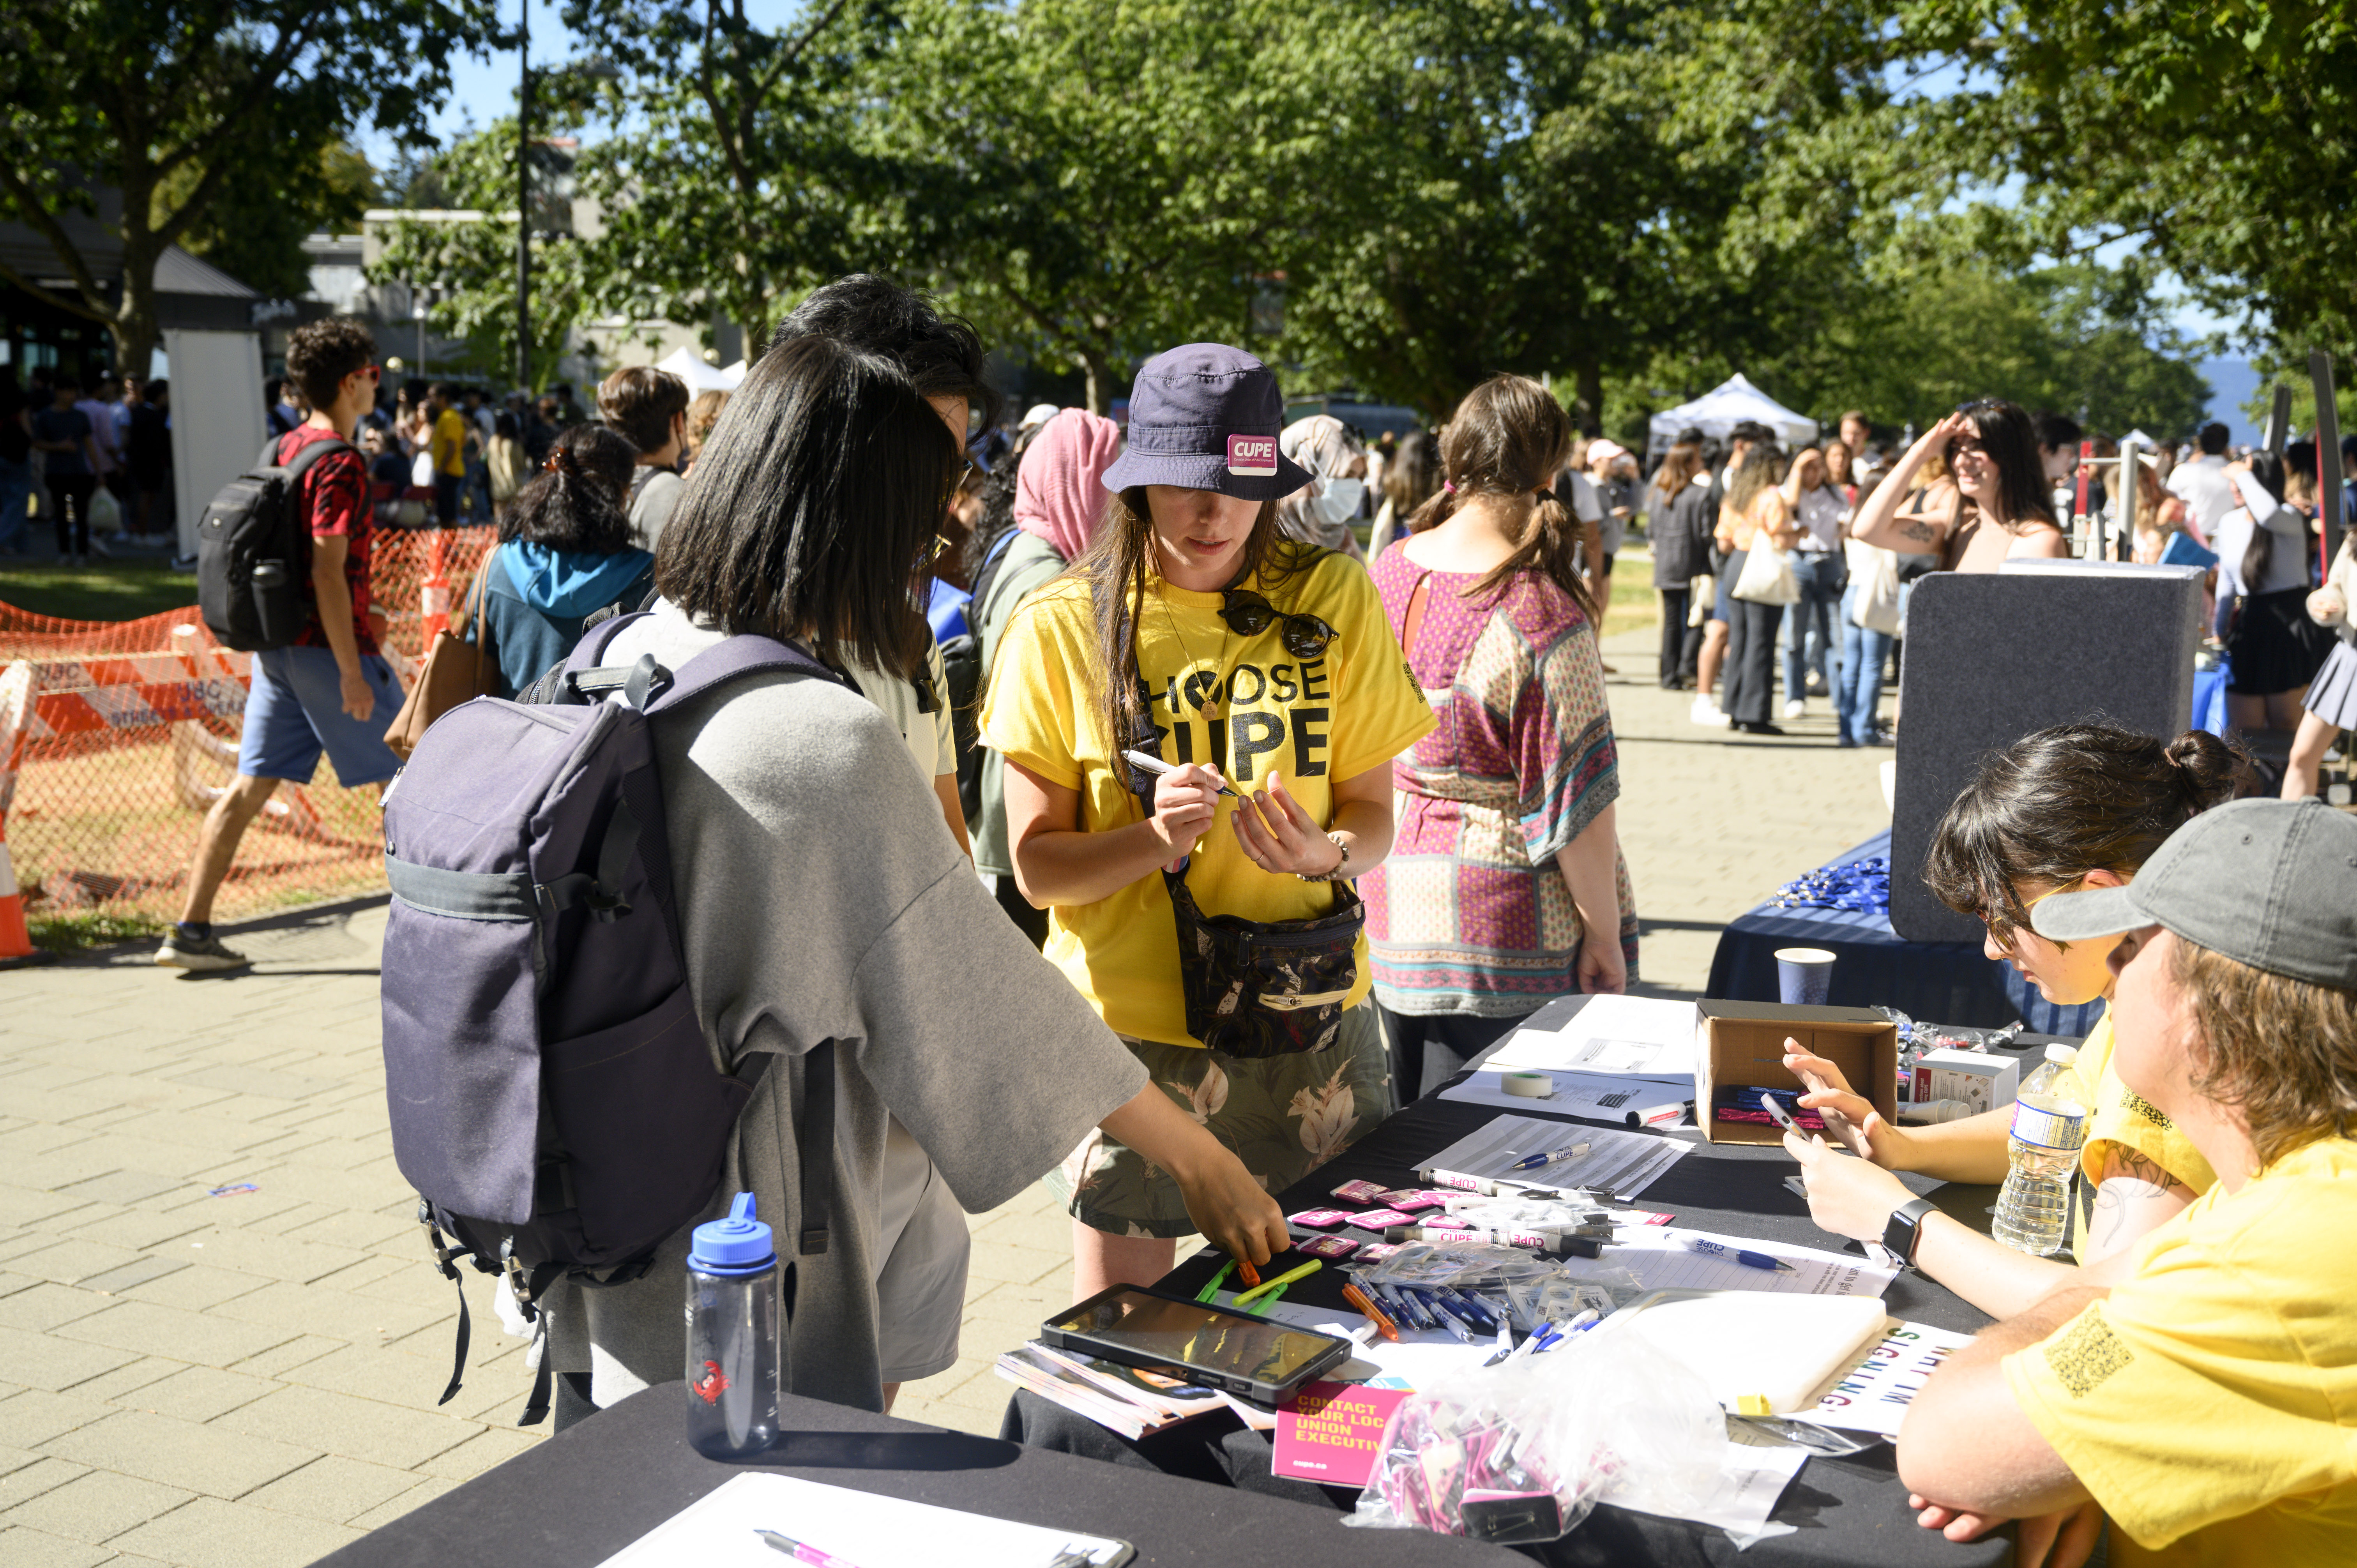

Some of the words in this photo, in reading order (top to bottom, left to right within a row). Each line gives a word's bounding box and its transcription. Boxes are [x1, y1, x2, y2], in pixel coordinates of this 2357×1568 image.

[1234, 442, 1272, 457] CUPE
[1143, 658, 1330, 714] HOOSE
[1556, 1150, 1573, 1160] CUPE
[1450, 1176, 1476, 1189] CUPE
[1349, 1184, 1380, 1199] CUPE
[1307, 1210, 1343, 1222] CUPE
[1366, 1213, 1406, 1225] CUPE
[1316, 1238, 1348, 1253] CUPE
[1514, 1234, 1544, 1247] CUPE
[1696, 1238, 1725, 1251] CUPE
[1696, 1246, 1723, 1256] CHOOSE
[1358, 1279, 1373, 1296] CUPE
[1838, 1282, 1853, 1291] get
[1298, 1395, 1376, 1415] CONTACT
[1297, 1406, 1345, 1423] YOUR
[1351, 1414, 1384, 1429] LOC
[1296, 1418, 1352, 1436] UNION
[1295, 1429, 1382, 1451] EXECUTIV
[1293, 1460, 1327, 1470] cupe.ca
